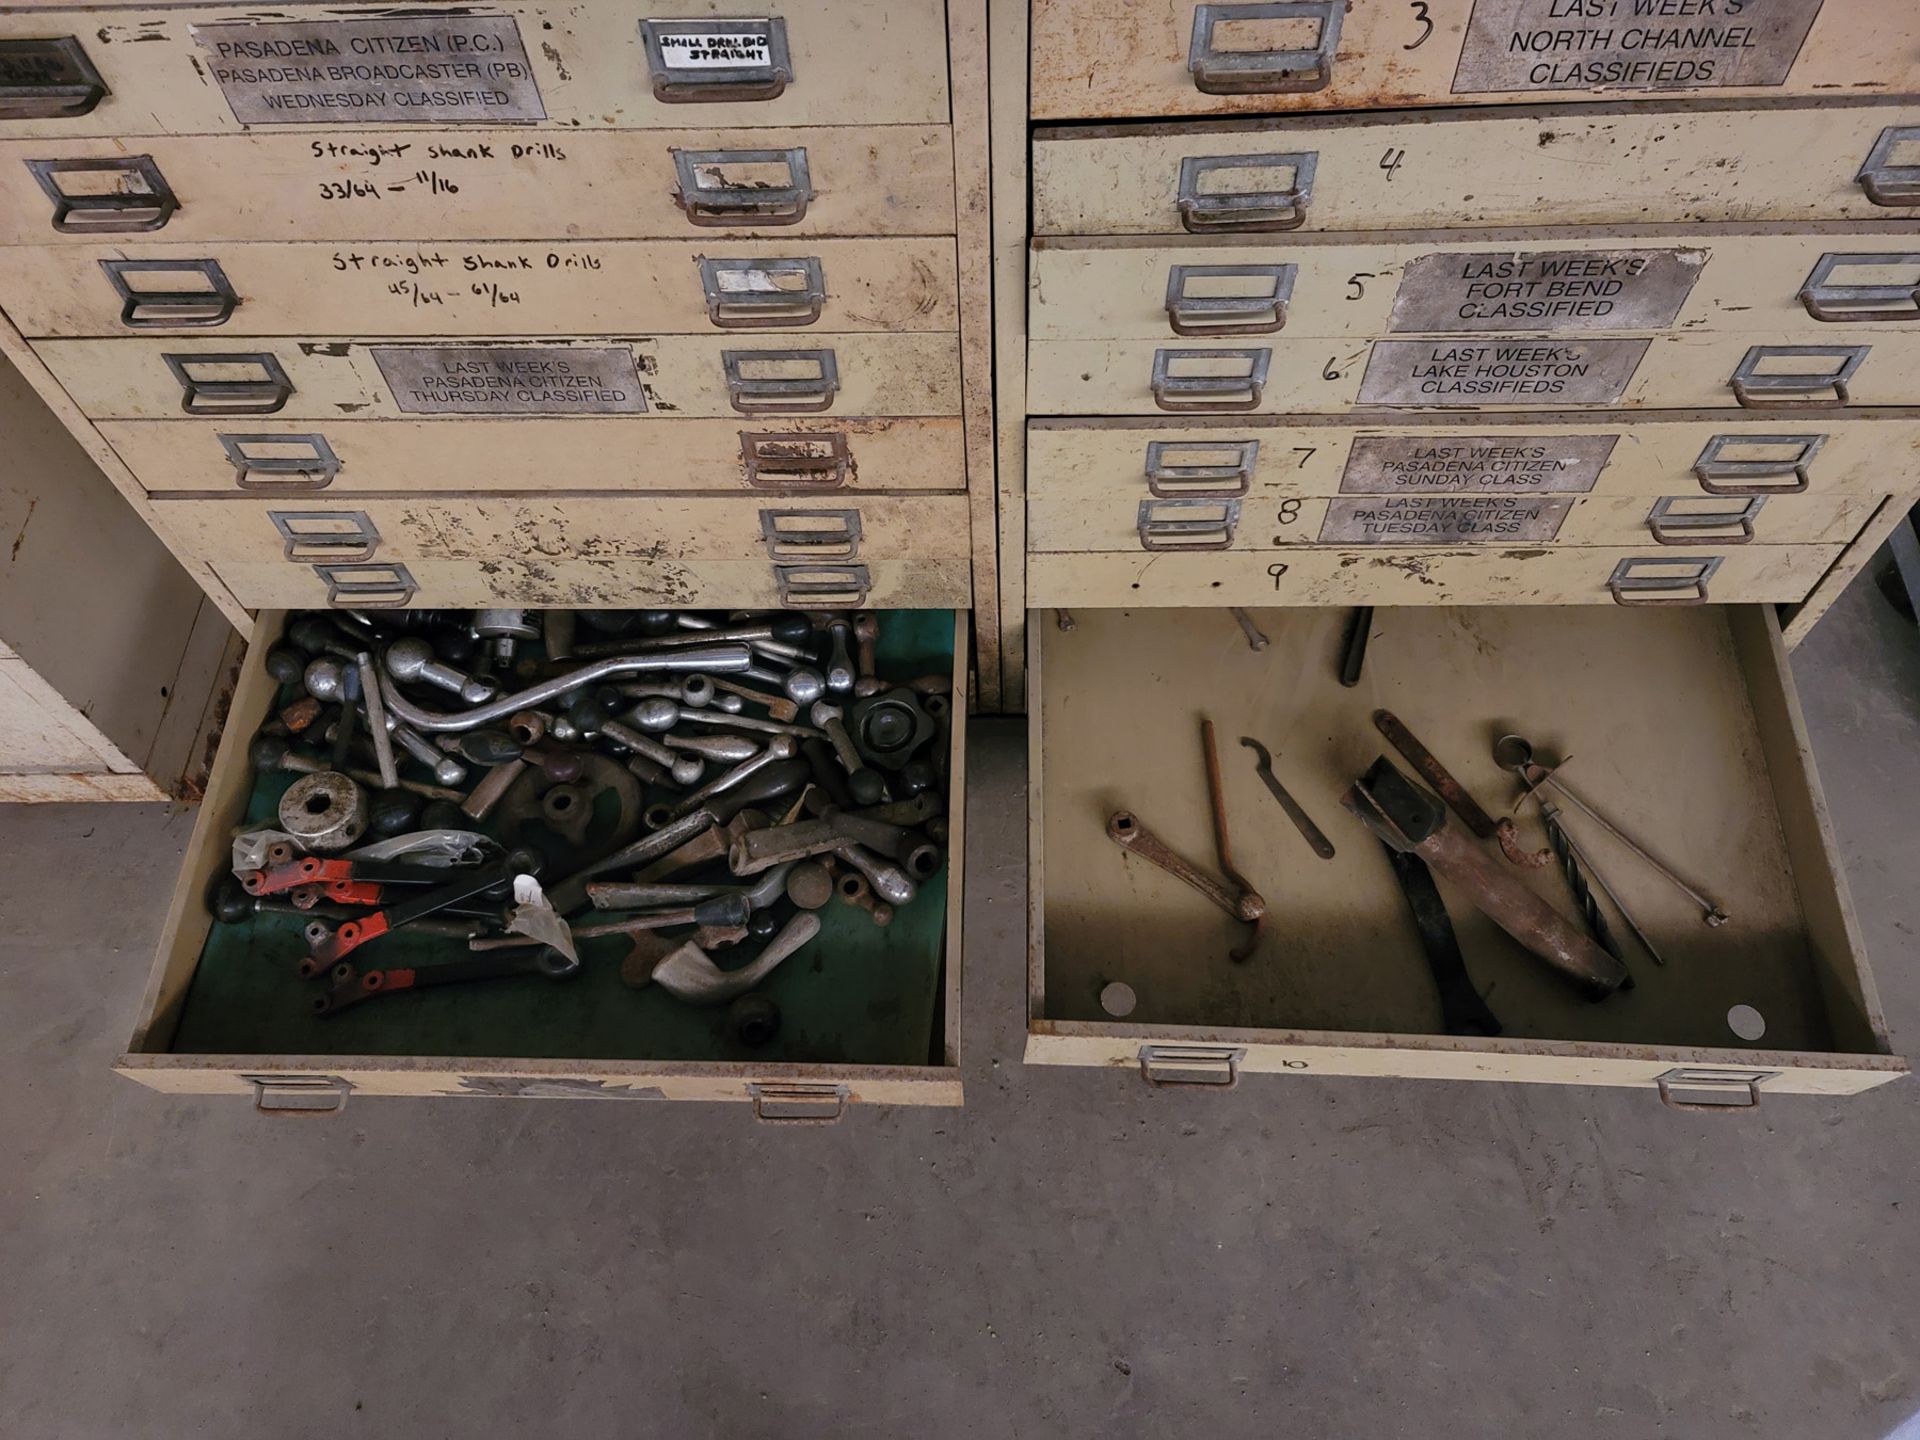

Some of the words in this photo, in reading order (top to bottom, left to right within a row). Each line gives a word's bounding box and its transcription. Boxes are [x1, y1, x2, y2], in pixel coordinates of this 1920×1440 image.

[1403, 1, 1434, 50] 3
[217, 39, 340, 59] PASADENA
[350, 35, 441, 55] CITIZEN
[447, 33, 504, 53] (P.C.)
[660, 36, 702, 48] SMALL
[1509, 29, 1613, 53] NORTH
[1621, 27, 1756, 51] CHANNEL
[689, 49, 763, 60] STRAIGHT
[216, 66, 323, 84] PASADENA
[327, 63, 481, 82] BROADCASTER
[487, 62, 528, 82] (PB)
[1529, 60, 1715, 84] CLASSIFIEDS
[261, 92, 387, 110] WEDNESDAY
[394, 90, 510, 107] CLASSIFIED
[311, 142, 411, 165] Straight
[1379, 148, 1405, 182] 4
[319, 179, 381, 200] 33/64
[416, 170, 460, 195] 11/16
[332, 252, 449, 274] Straight
[1462, 261, 1533, 280] LAST
[1540, 258, 1646, 278] WEEK'S
[472, 282, 521, 307] 61/64
[1345, 273, 1375, 301] 5
[1466, 282, 1541, 299] FORT
[1546, 280, 1623, 298] BEND
[1458, 301, 1614, 319] CLASSIFIED
[1431, 348, 1490, 362] LAST
[444, 362, 490, 374] LAST
[496, 361, 570, 374] WEEK'S
[1321, 357, 1340, 381] 6
[1411, 365, 1469, 378] LAKE
[1475, 364, 1589, 378] HOUSTON
[423, 376, 524, 389] PASADENA
[529, 376, 603, 388] CITIZEN
[1421, 380, 1566, 394] CLASSIFIEDS
[410, 390, 510, 402] THURSDAY
[516, 390, 626, 402] CLASSIFIED
[1293, 447, 1317, 469] 7
[1414, 447, 1465, 459] LAST
[1470, 446, 1546, 459] WEEK'S
[1382, 461, 1484, 473] PASADENA
[1490, 460, 1567, 472] CITIZEN
[1395, 474, 1474, 486] SUNDAY
[1479, 473, 1542, 485] CLASS
[1277, 498, 1301, 525] 8
[1384, 497, 1432, 509] LAST
[1436, 497, 1518, 508] WEEK'S
[1353, 510, 1458, 522] PASADENA
[1463, 509, 1540, 521] CITIZEN
[1362, 522, 1452, 534] TUESDAY
[1457, 522, 1521, 534] CLASS
[1267, 563, 1289, 591] 9
